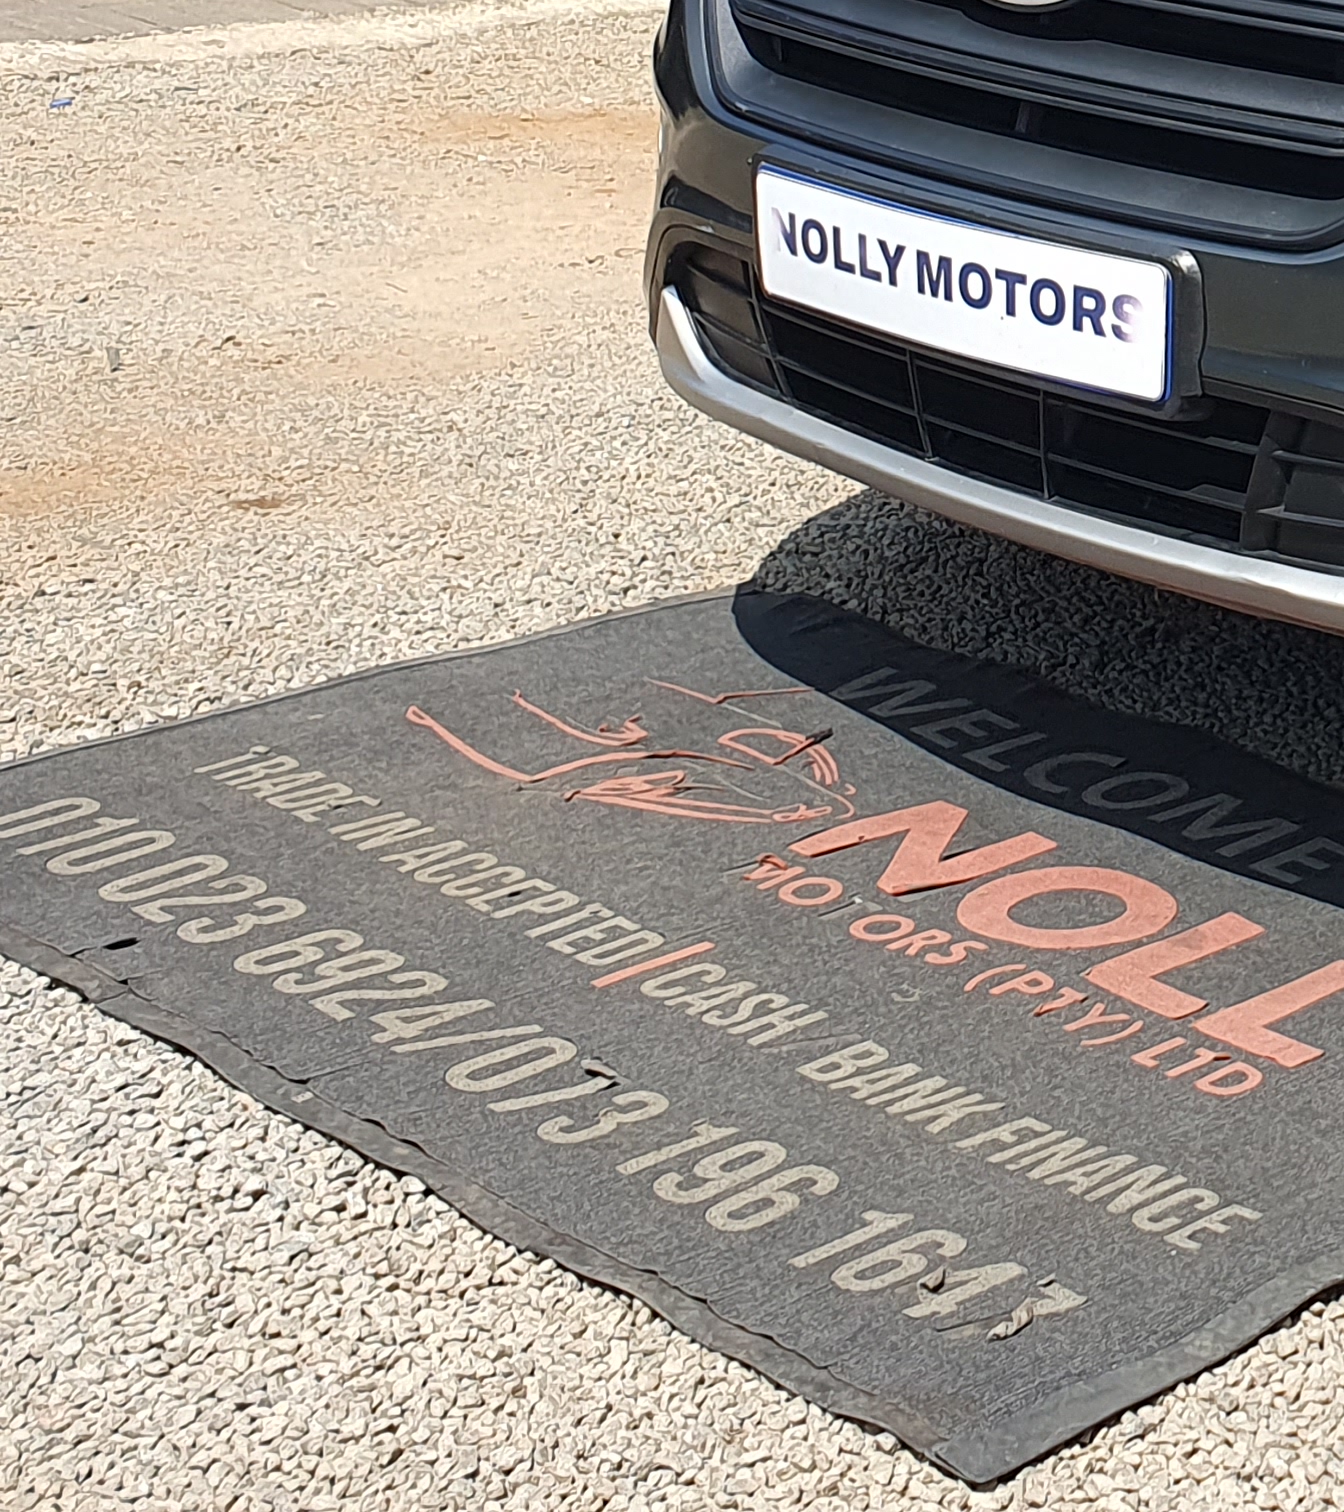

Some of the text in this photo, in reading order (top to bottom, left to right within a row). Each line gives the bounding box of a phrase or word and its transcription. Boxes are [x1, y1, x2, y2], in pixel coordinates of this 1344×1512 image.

[771, 206, 1144, 344] NOLLY MOTORS
[194, 744, 382, 824] TRADE
[328, 810, 436, 851] IN
[795, 1038, 1005, 1135] BANK
[955, 1115, 1263, 1252] FINANCE
[1129, 1036, 1263, 1096] LTD
[616, 1118, 840, 1232] 196
